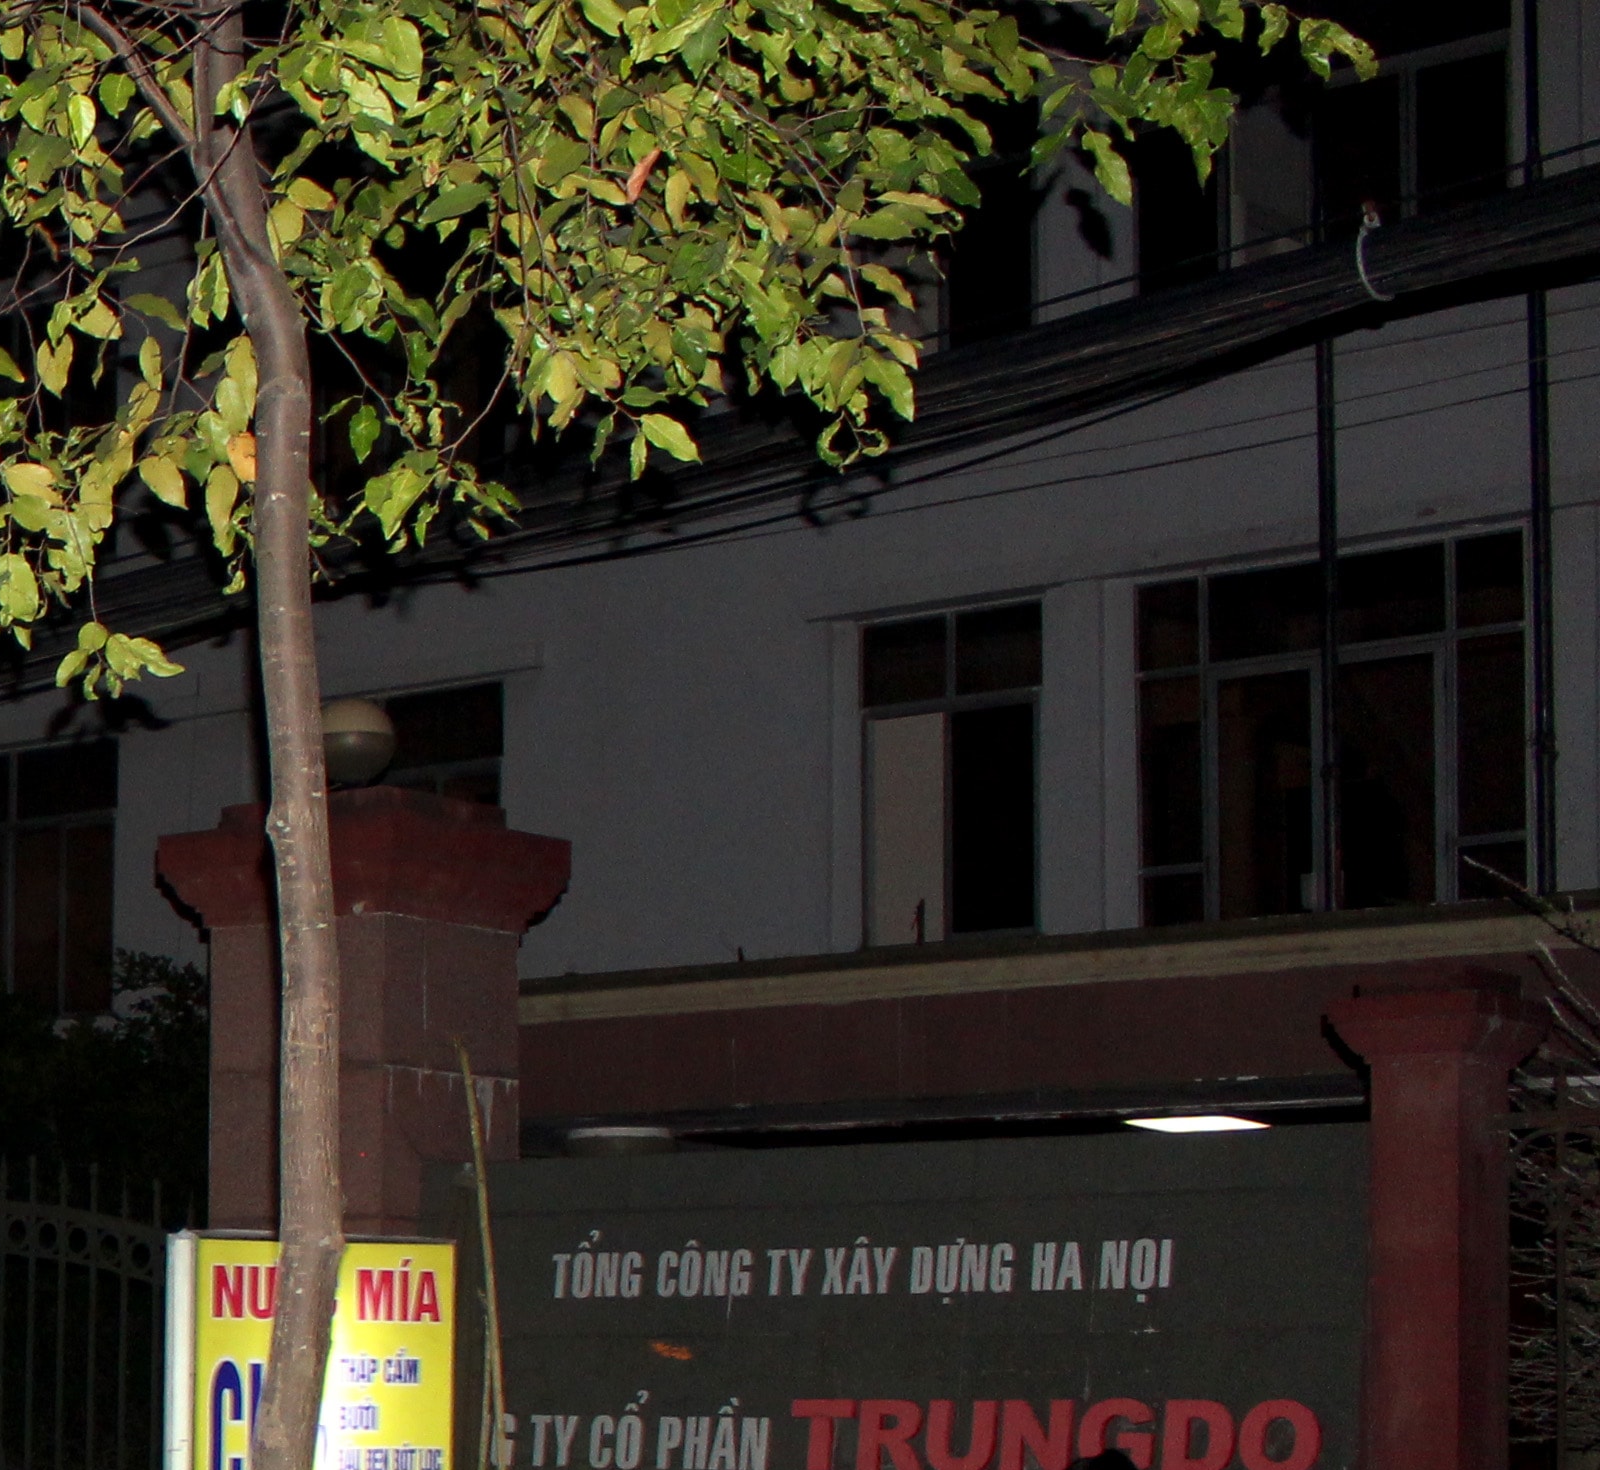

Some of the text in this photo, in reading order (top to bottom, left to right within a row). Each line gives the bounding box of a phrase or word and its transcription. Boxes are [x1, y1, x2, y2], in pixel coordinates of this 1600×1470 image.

[356, 1259, 442, 1323] MÍA
[552, 1229, 642, 1299] TỔNG
[656, 1237, 752, 1297] CÔNG
[767, 1248, 806, 1297] TY
[821, 1237, 894, 1296] XÂY
[910, 1238, 1014, 1304] DỰNG
[531, 1414, 580, 1467] TY
[589, 1390, 652, 1470] CỔ
